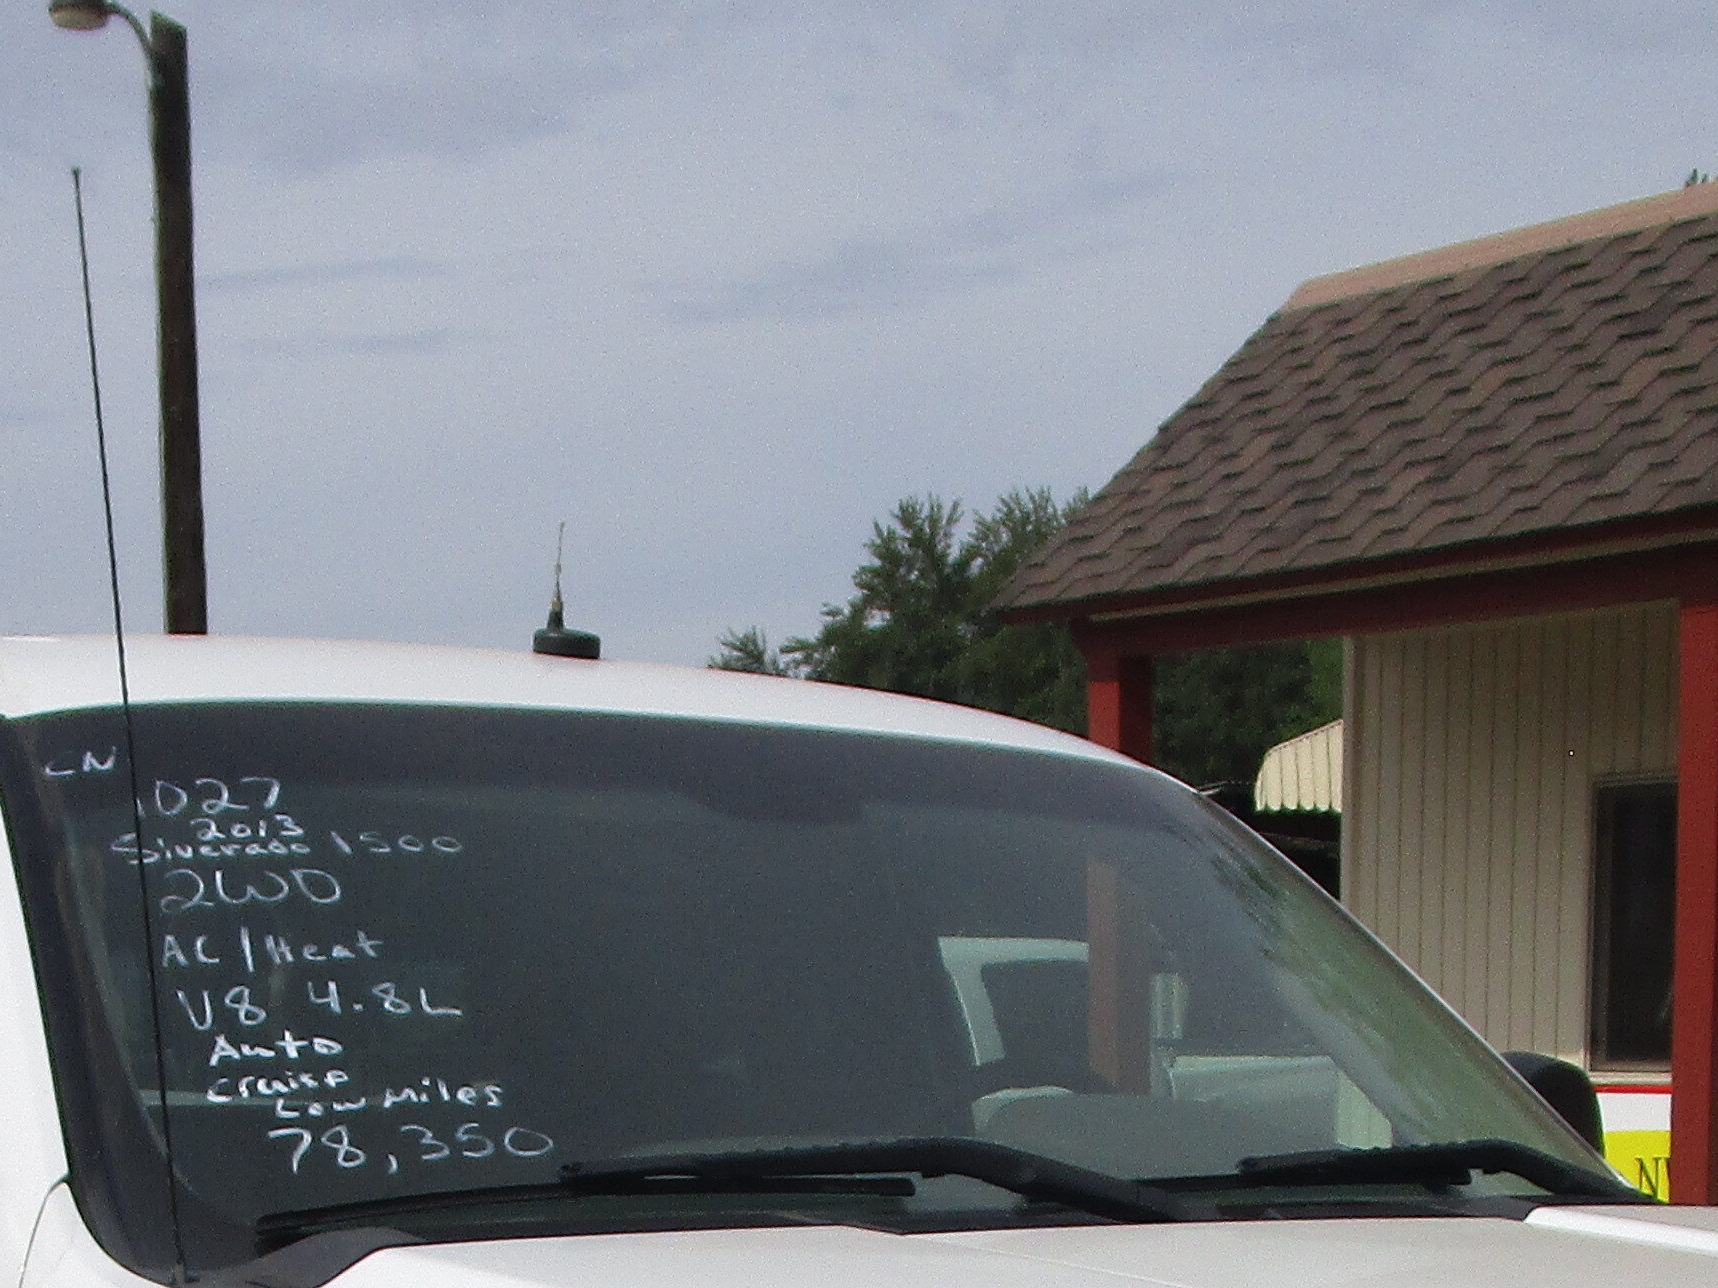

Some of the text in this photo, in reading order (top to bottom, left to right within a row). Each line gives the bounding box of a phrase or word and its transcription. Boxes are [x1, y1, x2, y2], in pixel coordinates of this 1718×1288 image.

[189, 813, 305, 842] 2013
[330, 831, 463, 855] 1500
[159, 868, 342, 913] 2WD
[307, 979, 463, 1016] 4.8L
[208, 1028, 344, 1067] Auto
[267, 1121, 555, 1176] 78,350
